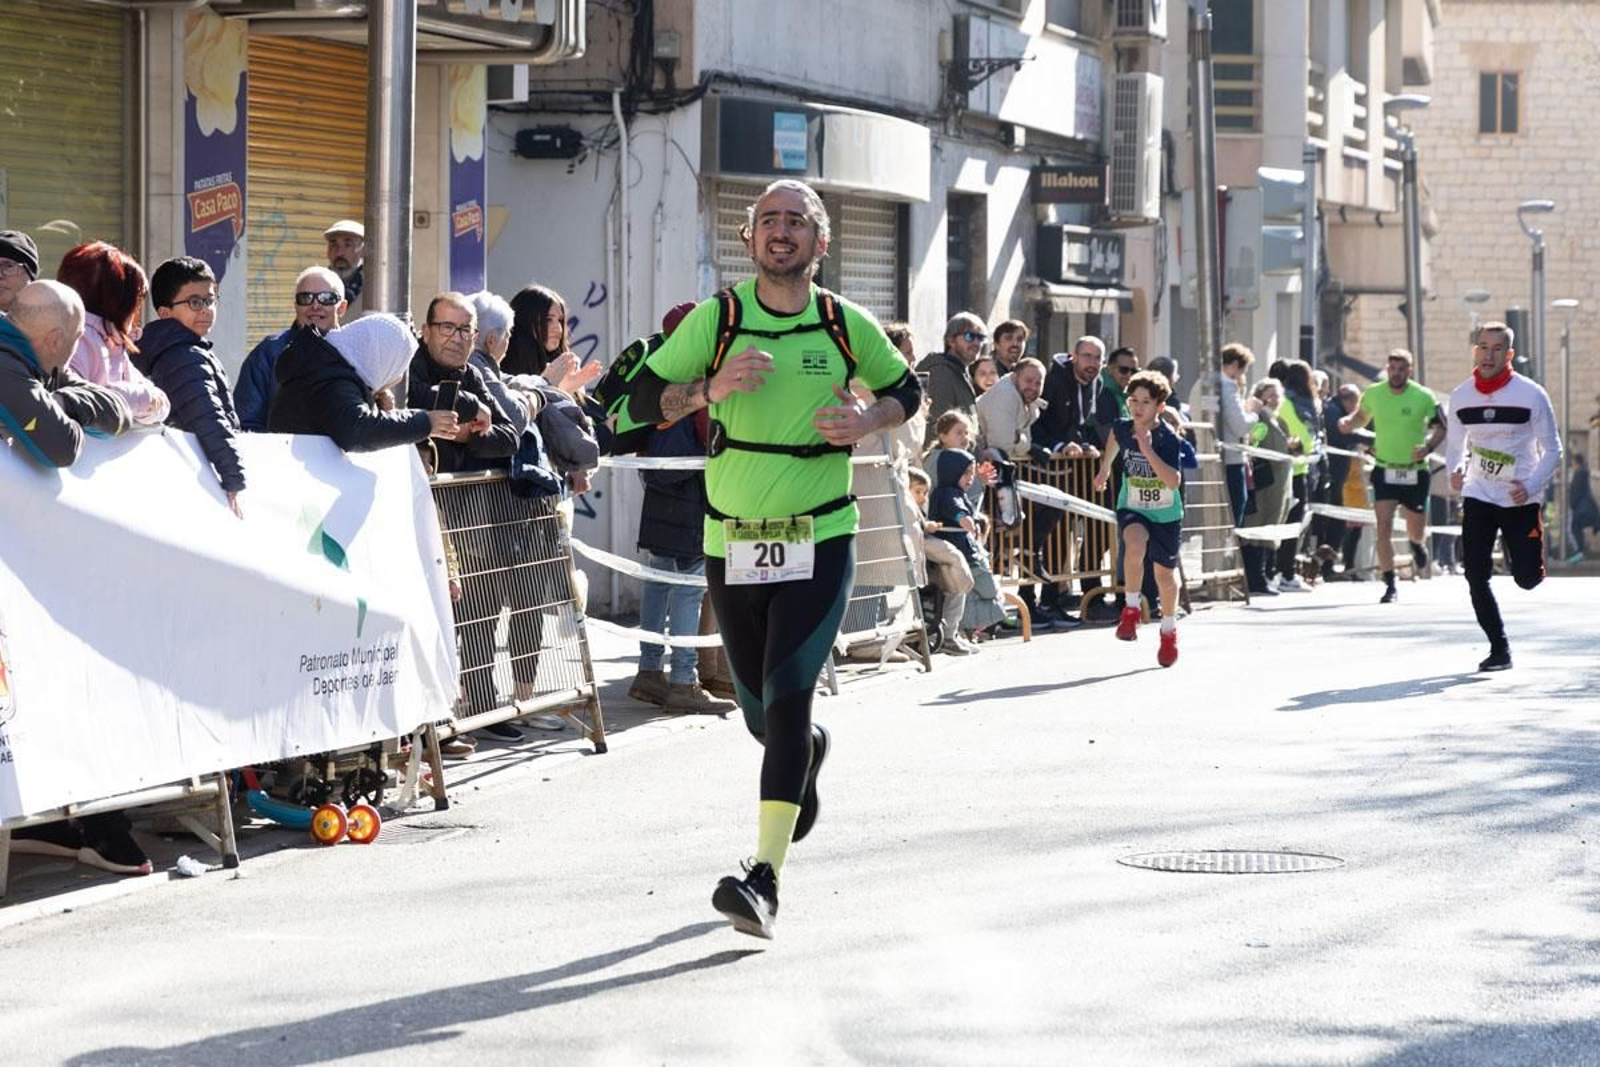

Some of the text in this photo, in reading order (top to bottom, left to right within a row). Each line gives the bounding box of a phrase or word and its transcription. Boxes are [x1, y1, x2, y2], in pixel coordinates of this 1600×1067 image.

[1041, 172, 1099, 189] Mahou
[195, 192, 238, 219] Casa Paco
[1480, 458, 1504, 475] 497
[1139, 488, 1161, 502] 198
[754, 542, 786, 567] 20
[299, 651, 349, 672] Patronato
[313, 674, 360, 698] Deportes
[362, 672, 375, 688] de
